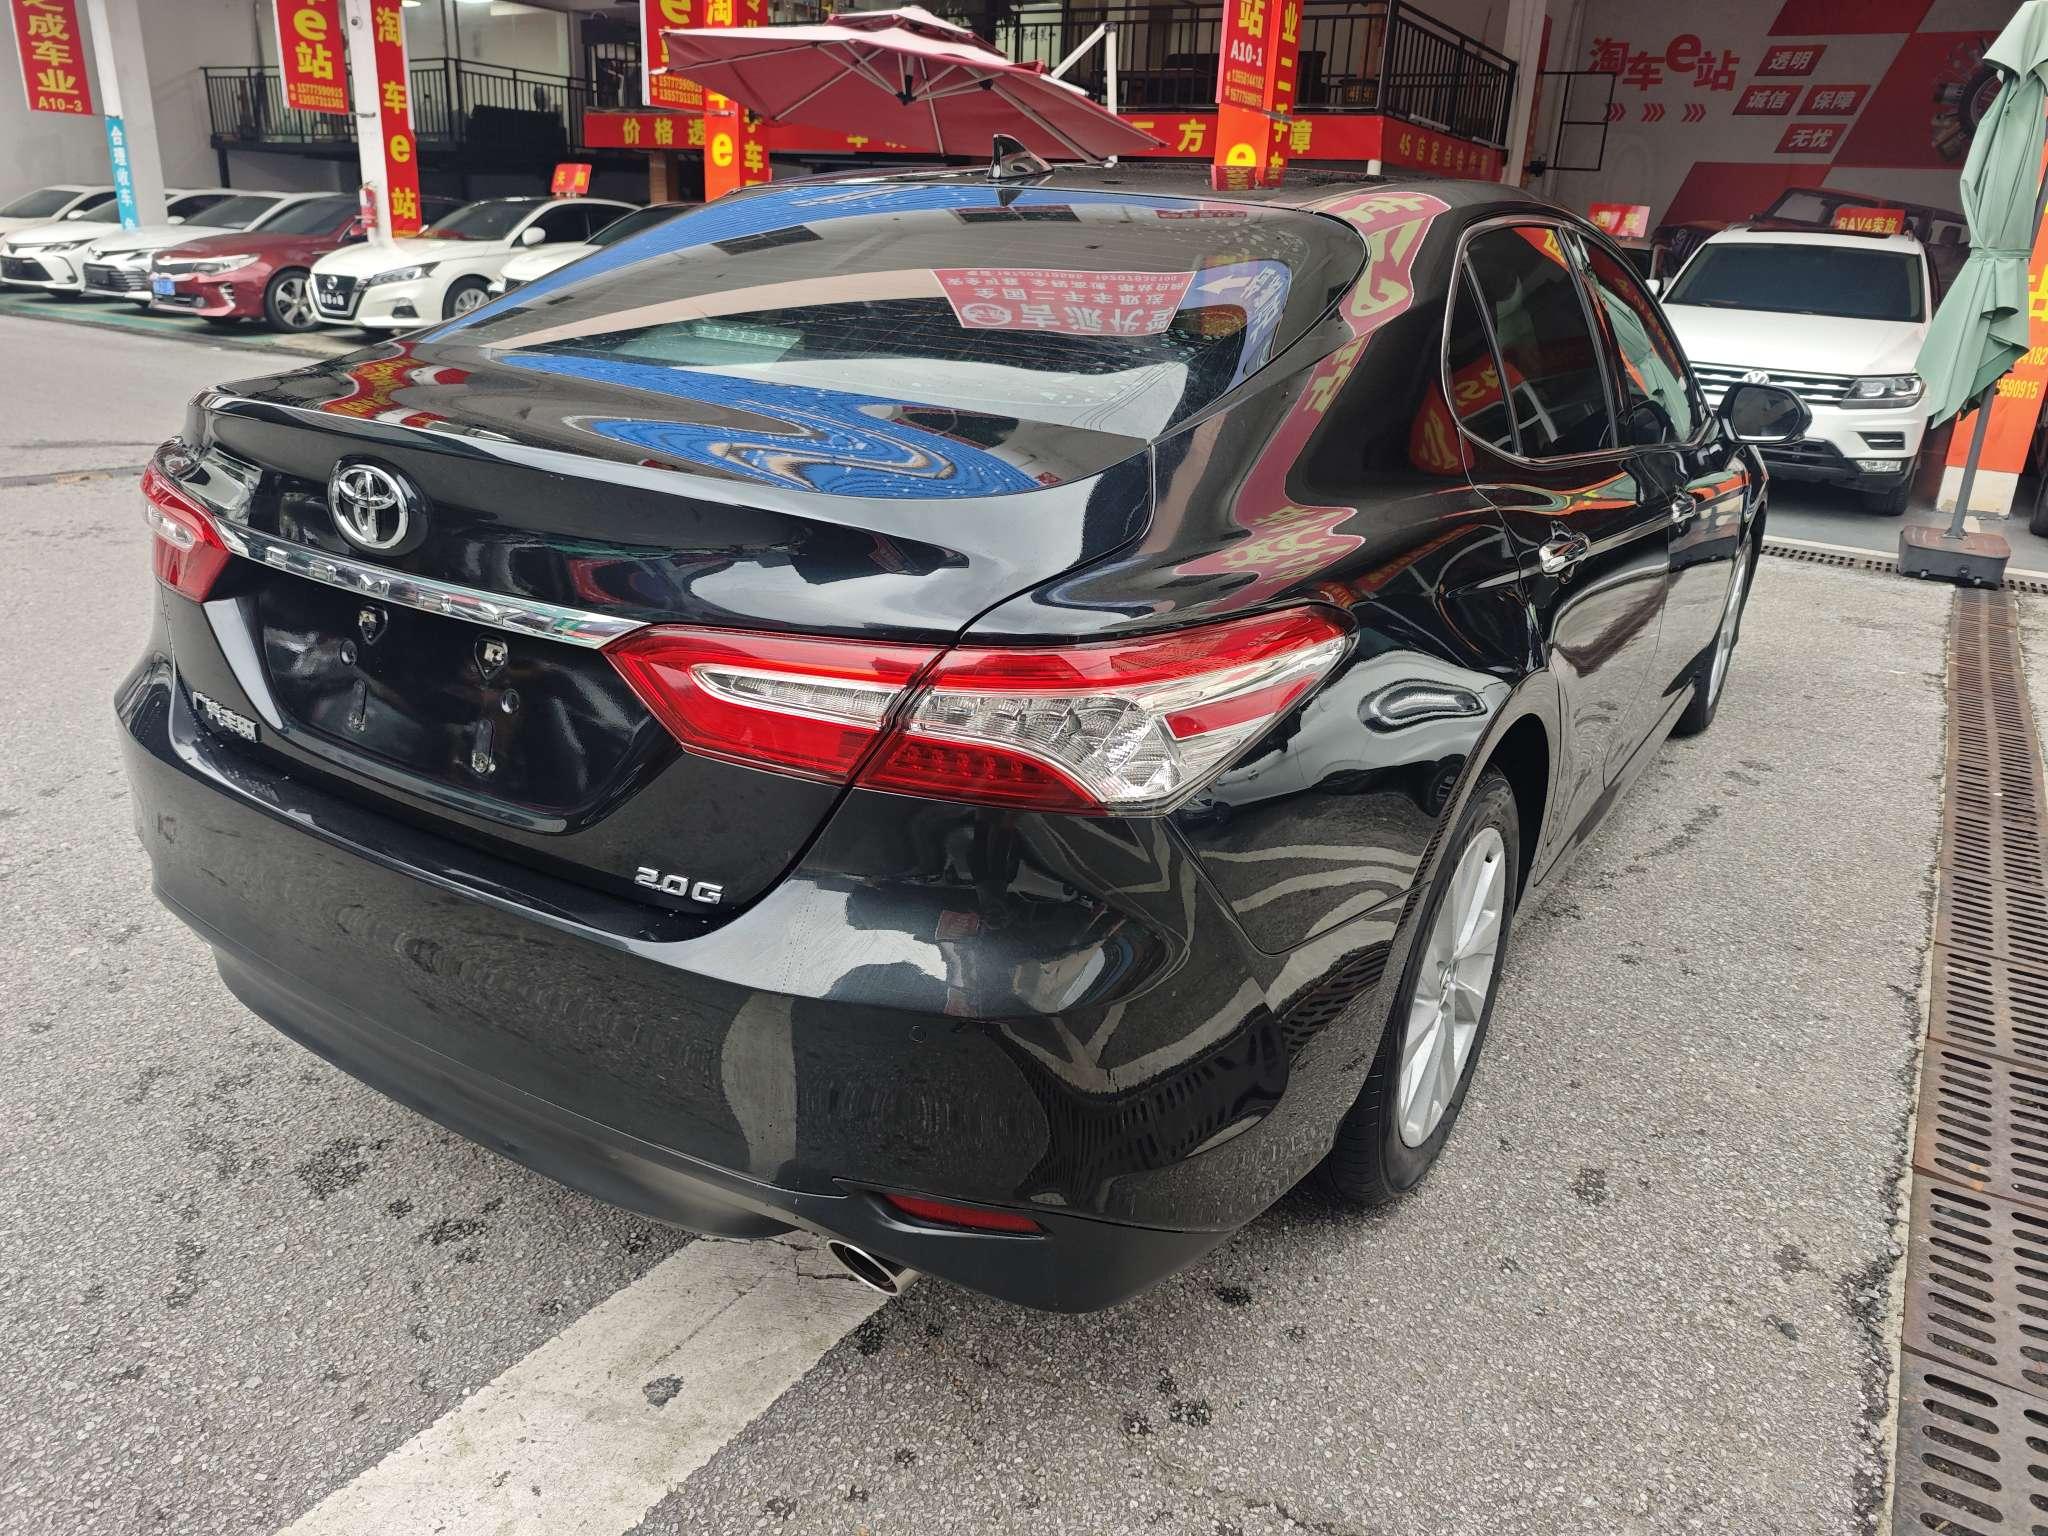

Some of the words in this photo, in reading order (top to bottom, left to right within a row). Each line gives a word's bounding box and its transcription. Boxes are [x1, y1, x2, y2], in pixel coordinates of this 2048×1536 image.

[293, 0, 333, 80] e站
[1231, 40, 1262, 67] A10-1
[1589, 34, 1741, 91] 淘车e站
[1767, 51, 1814, 70] 透明
[38, 96, 83, 112] A10-3
[1746, 90, 1791, 109] 诚信
[1812, 91, 1857, 109] 保障
[376, 6, 418, 220] 淘车e站
[1788, 129, 1833, 147] 无忧
